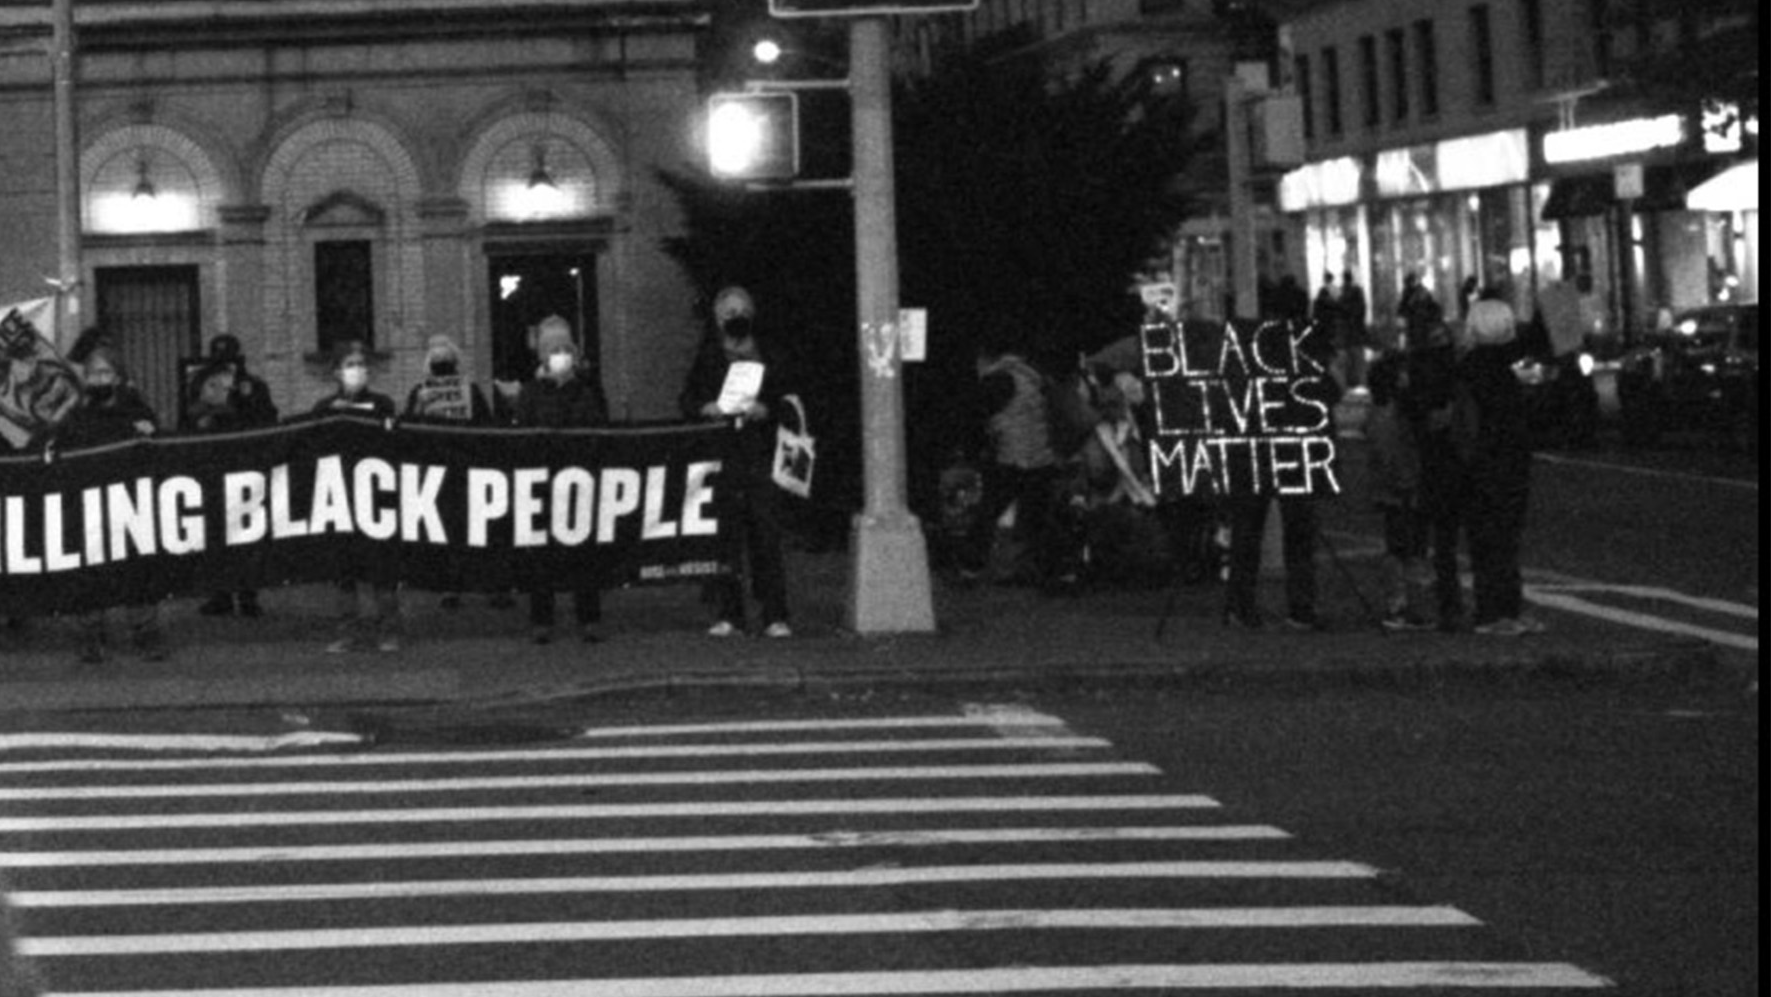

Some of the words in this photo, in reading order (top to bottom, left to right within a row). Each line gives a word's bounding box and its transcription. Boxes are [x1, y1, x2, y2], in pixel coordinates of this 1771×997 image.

[1140, 320, 1325, 377] BLACK
[1153, 376, 1329, 435] LIVES
[1149, 436, 1341, 495] MATTER
[224, 453, 449, 546] BLACK
[467, 460, 723, 547] PEOPLE
